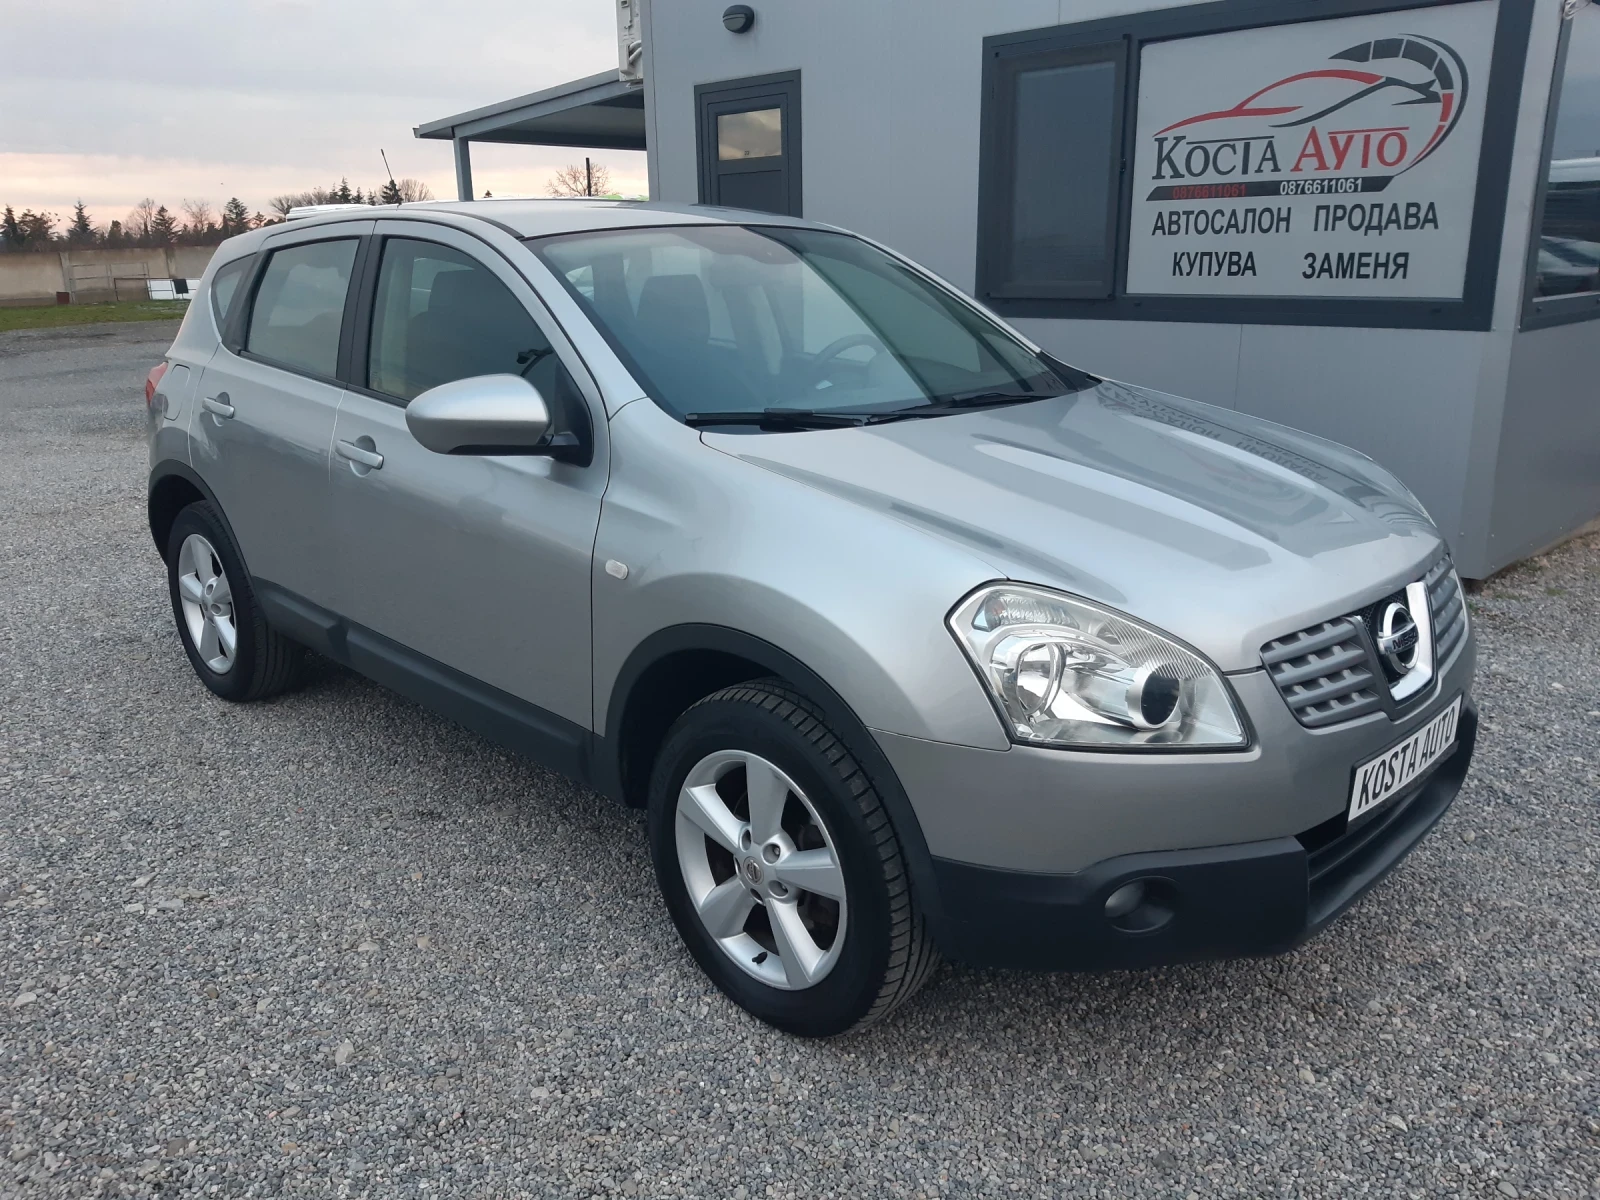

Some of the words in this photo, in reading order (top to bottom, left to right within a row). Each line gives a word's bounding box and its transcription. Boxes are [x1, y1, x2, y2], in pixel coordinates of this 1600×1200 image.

[1172, 183, 1247, 200] 0876611061
[1279, 177, 1363, 195] 0876611061
[1151, 206, 1292, 236] АВТОСАЛОН
[1313, 201, 1439, 236] ПРОДАВА
[1171, 250, 1257, 277] КУПУВА
[1301, 251, 1410, 279] ЗАМЕНЯ
[1357, 741, 1418, 811] KOSTA
[1418, 705, 1456, 764] AUTO
